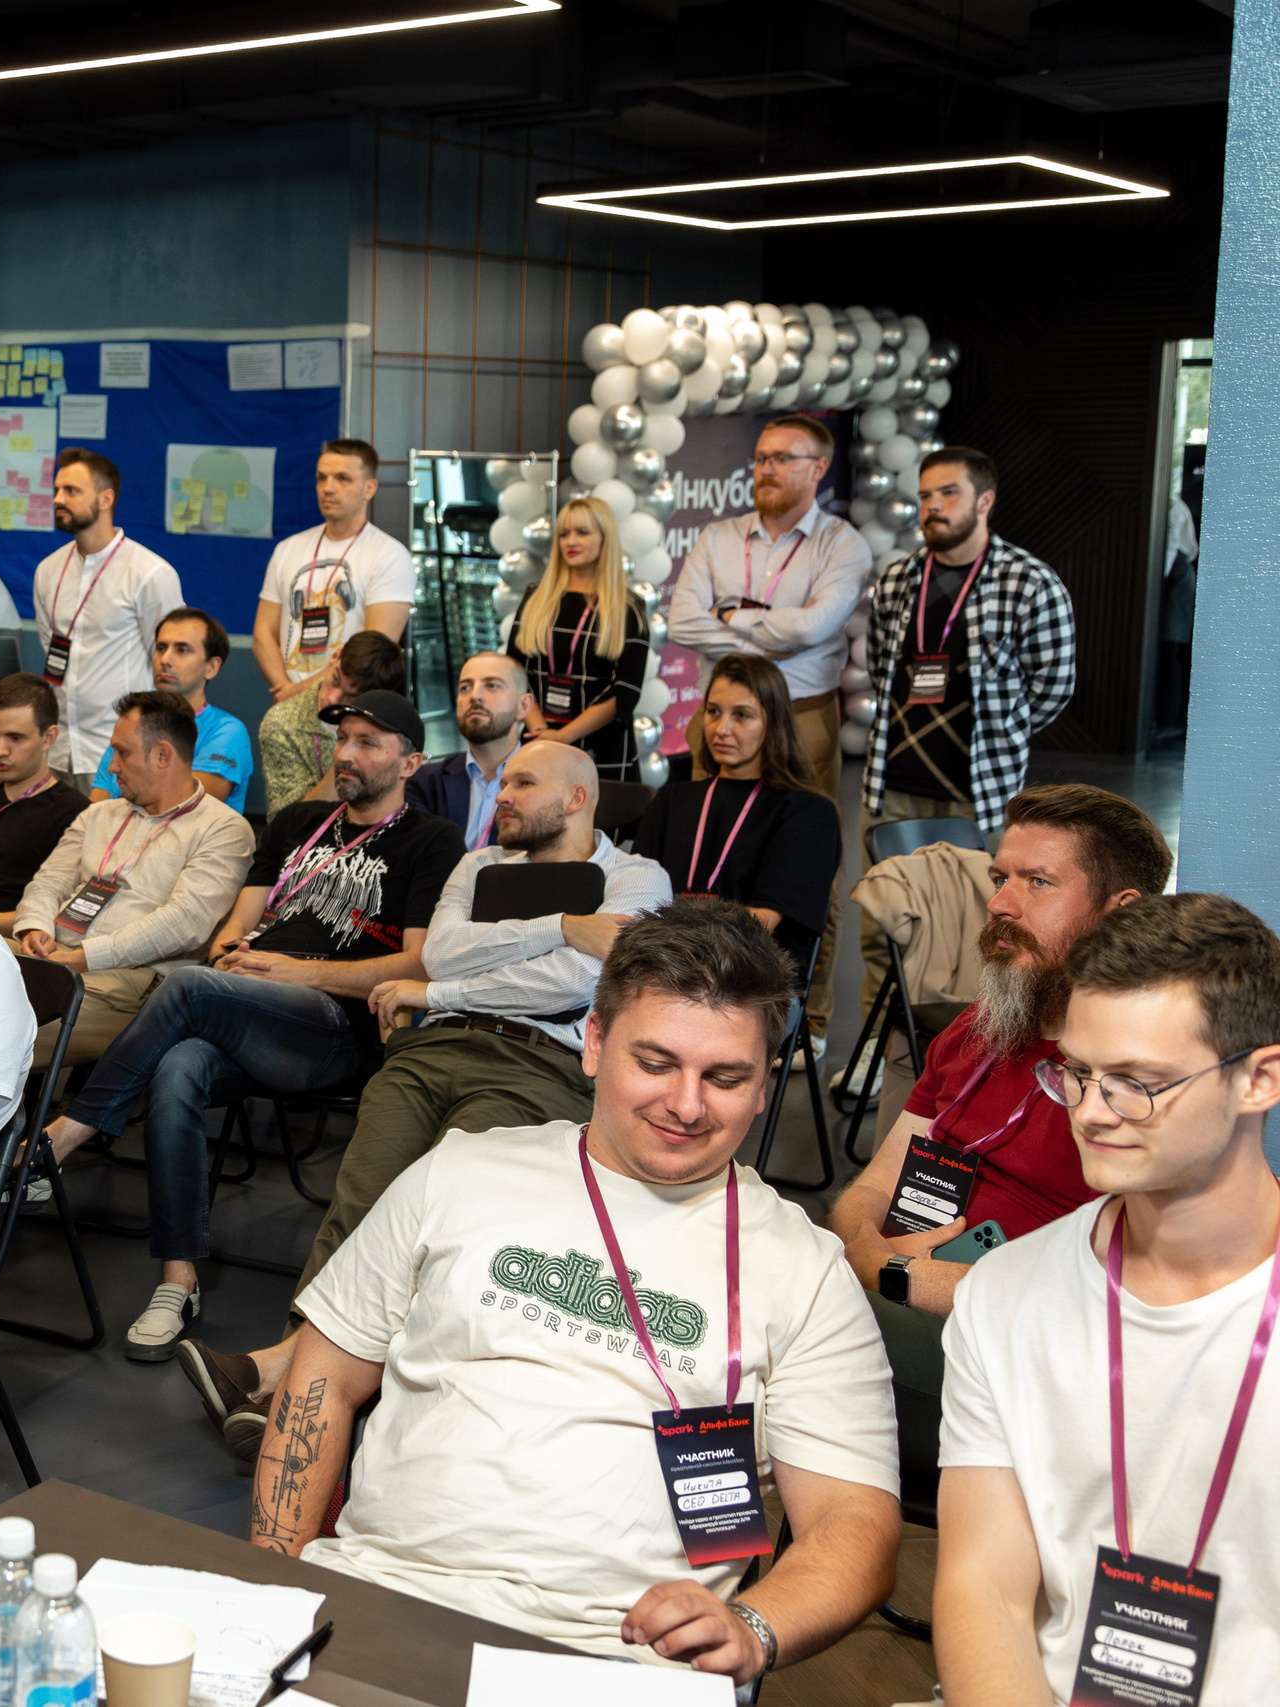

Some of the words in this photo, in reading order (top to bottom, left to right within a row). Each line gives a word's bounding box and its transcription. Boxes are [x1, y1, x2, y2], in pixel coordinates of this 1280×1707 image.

[915, 1170, 957, 1192] УЧАСТНИК
[909, 1190, 941, 1206] Сергей
[487, 1244, 709, 1351] adidas
[480, 1290, 697, 1375] SPORTSWEAR
[661, 1423, 694, 1437] spark
[699, 1420, 727, 1434] Альфа
[728, 1418, 750, 1427] Банк
[676, 1448, 735, 1464] УЧАСТНИК
[682, 1496, 706, 1510] CEO
[711, 1491, 741, 1504] DELTA
[1114, 1600, 1190, 1631] УЧАСТНИК
